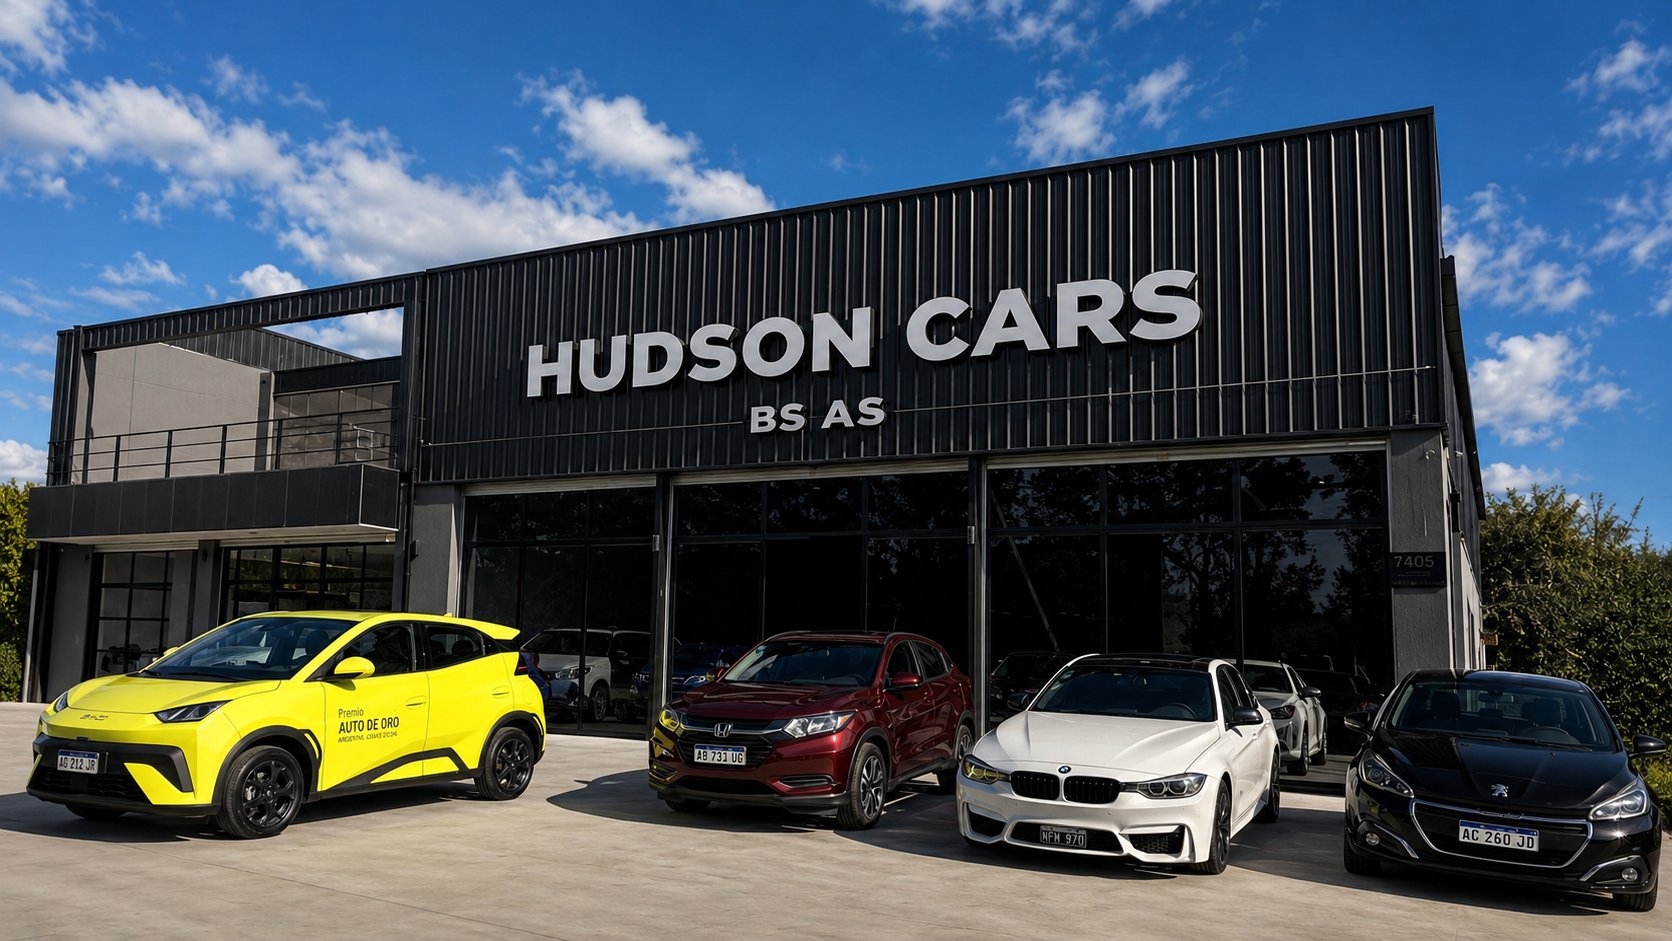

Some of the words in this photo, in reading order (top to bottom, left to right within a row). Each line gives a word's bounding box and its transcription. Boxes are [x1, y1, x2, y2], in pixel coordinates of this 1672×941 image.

[527, 306, 873, 398] HUDSON
[906, 269, 1202, 361] CARS
[750, 402, 806, 433] BS
[820, 396, 886, 429] AS
[1393, 555, 1434, 568] 7405
[338, 708, 364, 719] Premio
[338, 720, 365, 734] AUTO
[367, 718, 379, 731] DE
[381, 716, 400, 729] ORO
[70, 758, 84, 770] 212
[1065, 833, 1084, 846] 970
[1462, 828, 1479, 841] AC
[1484, 831, 1511, 846] 260
[1516, 835, 1534, 849] JD
